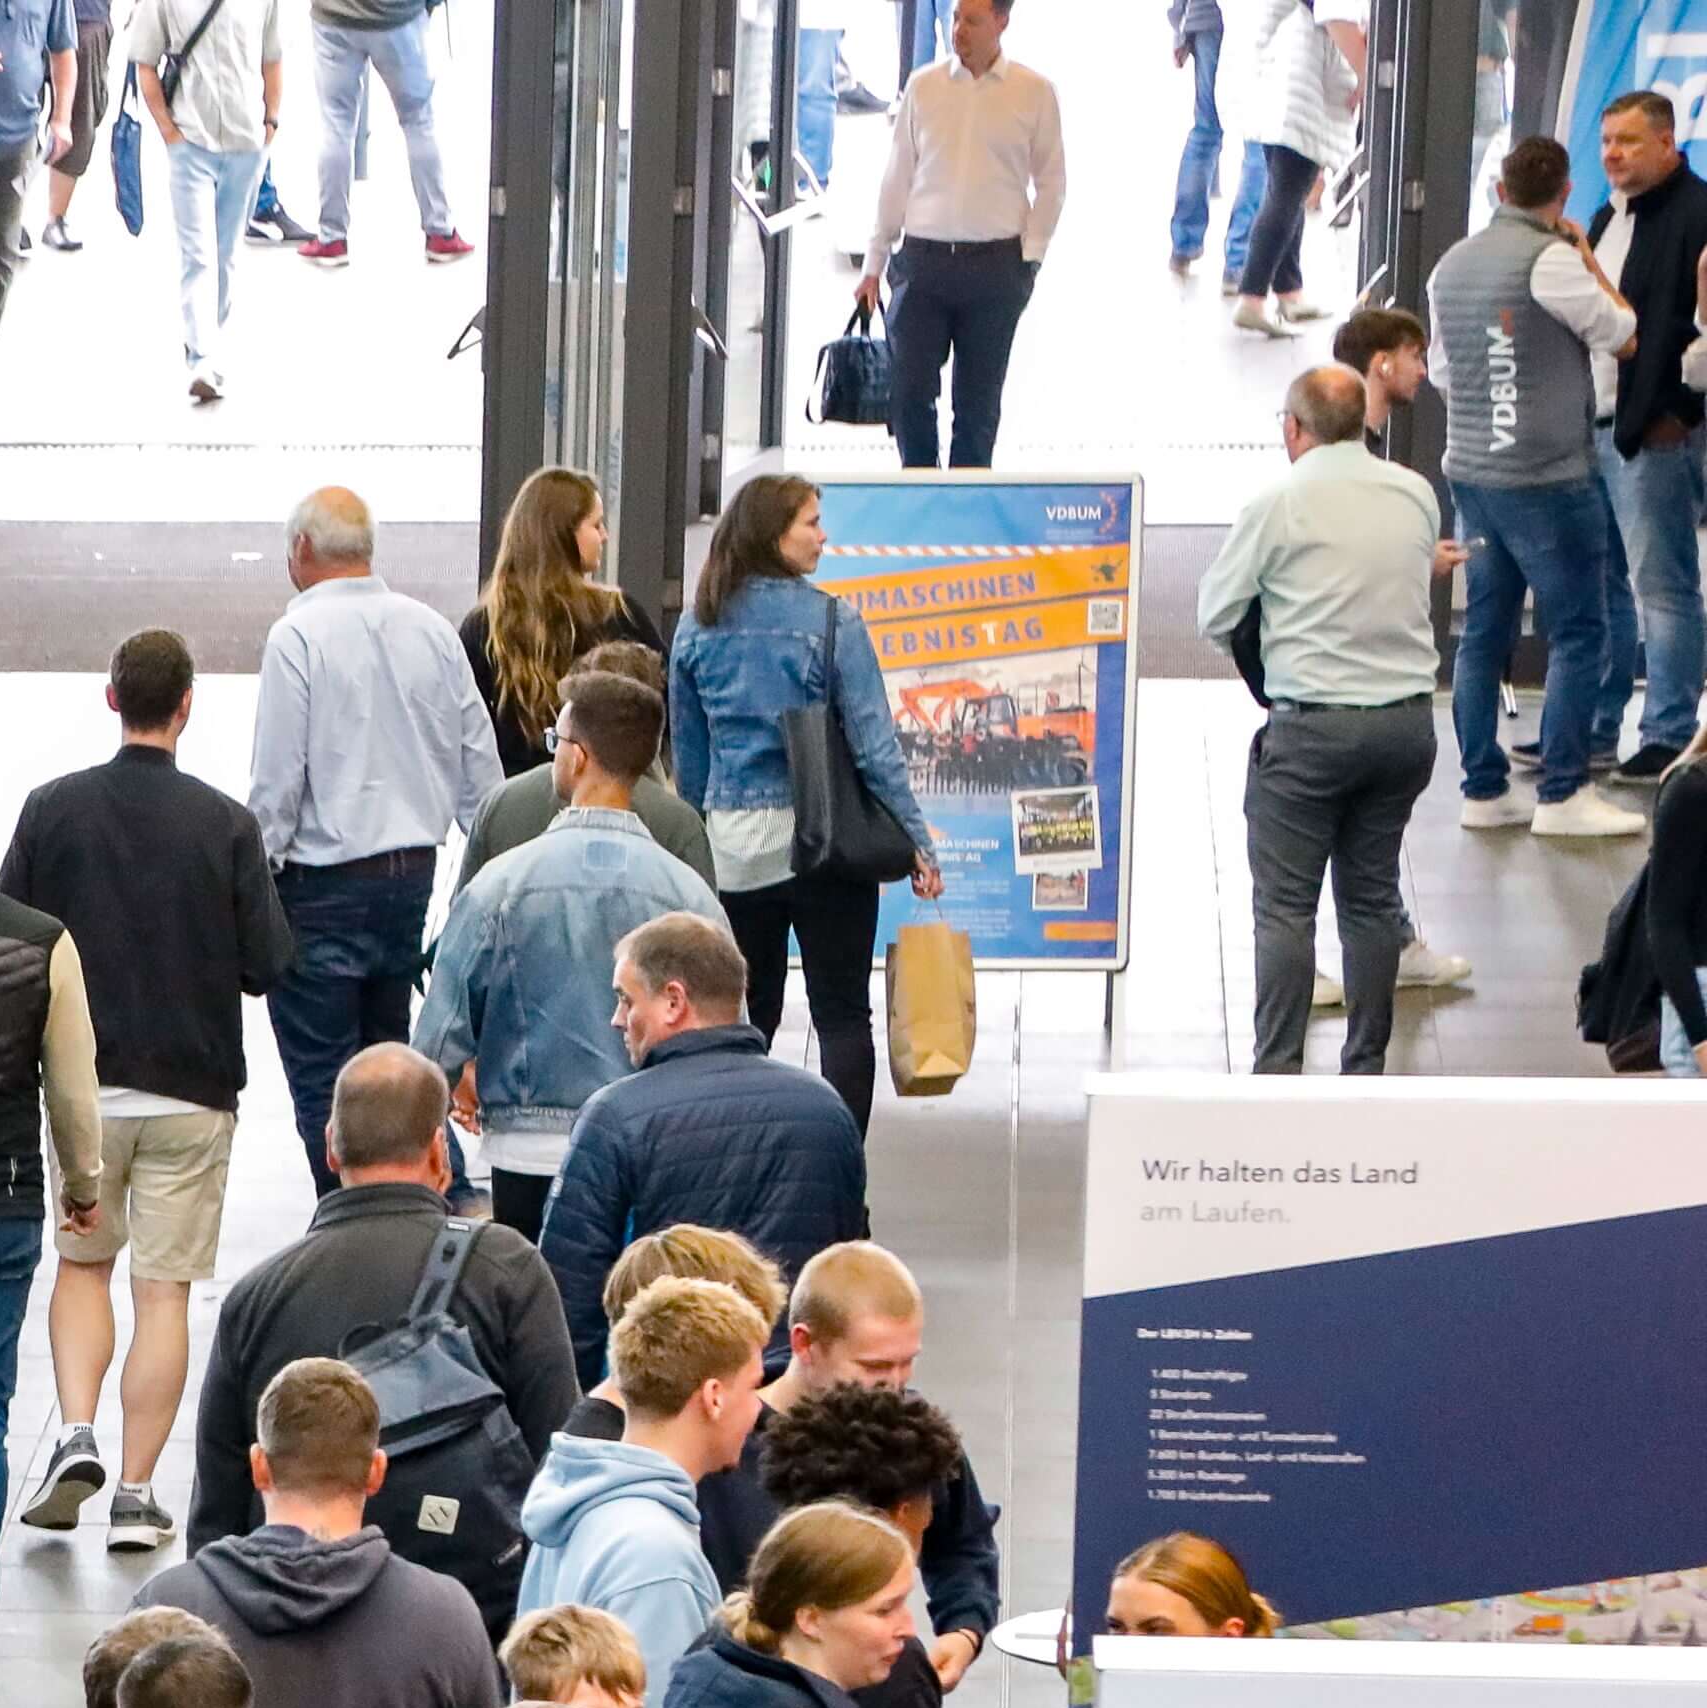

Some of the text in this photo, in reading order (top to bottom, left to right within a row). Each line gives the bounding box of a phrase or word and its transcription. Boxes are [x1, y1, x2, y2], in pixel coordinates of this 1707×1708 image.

[1486, 326, 1518, 453] VDBUM
[1045, 504, 1102, 521] VDBUM
[881, 617, 1044, 656] EBNISTAG
[1142, 1159, 1419, 1184] Wir halten das Land
[1139, 1200, 1292, 1224] am Laufen.
